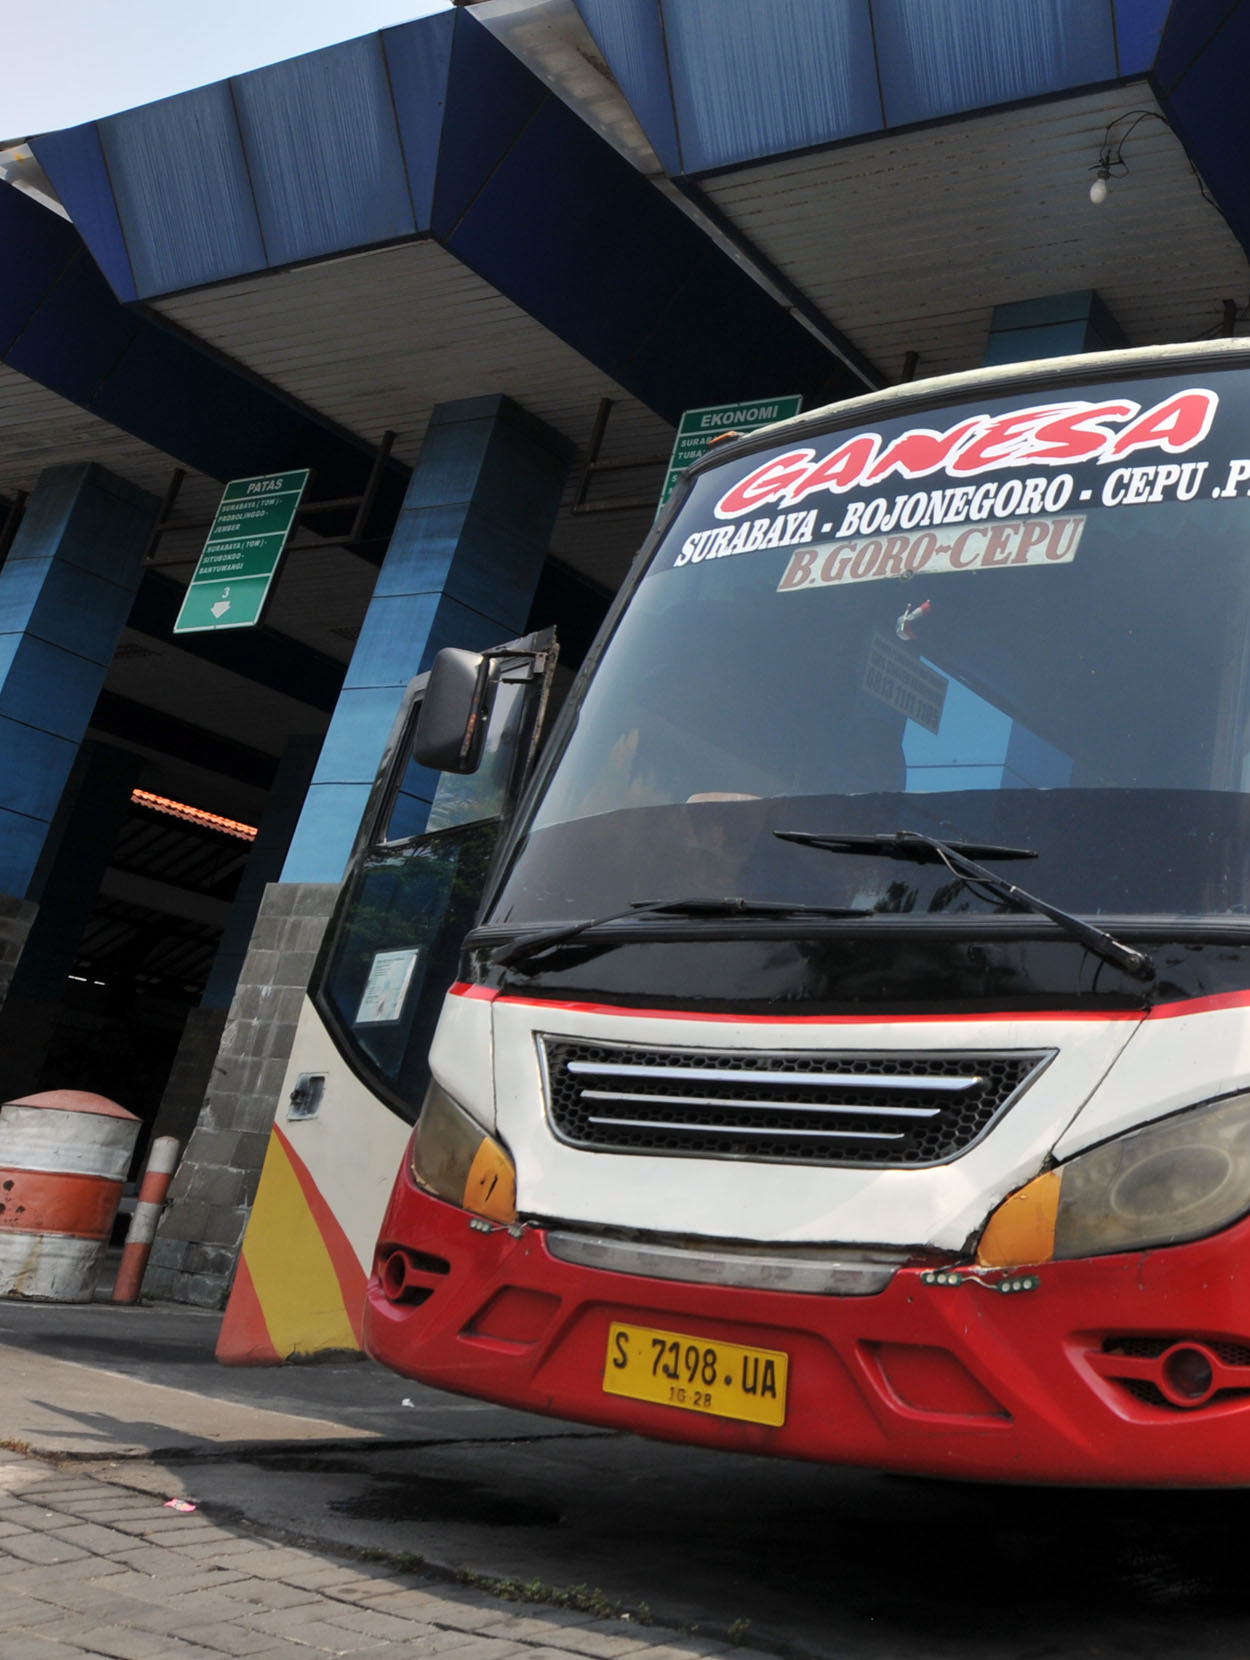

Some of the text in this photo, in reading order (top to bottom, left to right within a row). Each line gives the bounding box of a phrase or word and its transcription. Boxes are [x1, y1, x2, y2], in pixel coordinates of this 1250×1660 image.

[700, 405, 779, 427] EKONOMI
[681, 436, 712, 447] SURAB
[678, 449, 706, 459] TUBA
[713, 388, 1219, 519] GANESA
[247, 478, 283, 494] PATAS
[673, 509, 818, 567] SURABAYA
[836, 474, 1074, 538] BOJONEGORO
[1101, 462, 1209, 507] CEPU
[221, 586, 230, 599] 3
[613, 1331, 777, 1399] S 7198 UA
